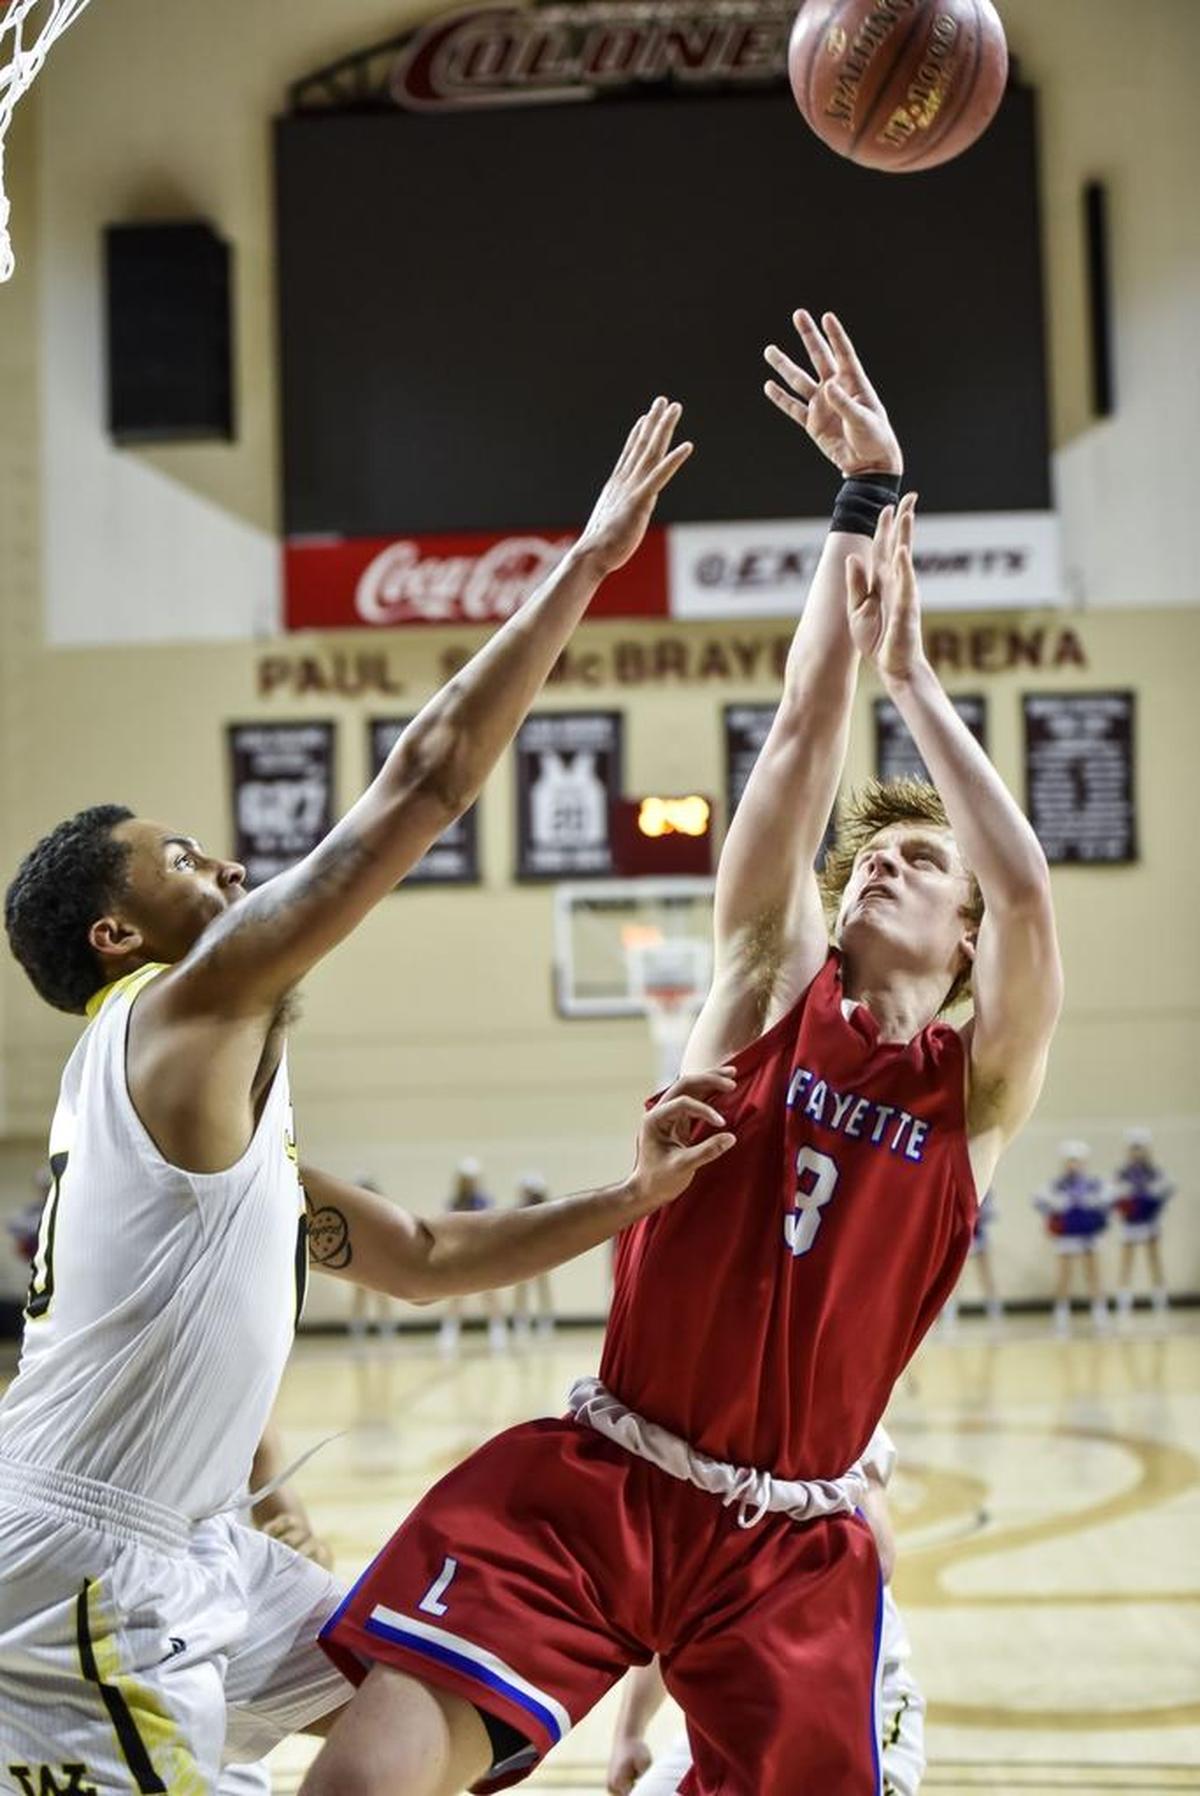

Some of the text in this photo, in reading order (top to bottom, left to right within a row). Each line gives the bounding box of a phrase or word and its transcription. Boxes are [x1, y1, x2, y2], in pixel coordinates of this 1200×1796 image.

[390, 6, 790, 112] COLONE
[258, 650, 404, 700] PAUL
[929, 626, 1088, 674] RENA
[785, 1066, 930, 1163] FAYETTE
[783, 1145, 840, 1258] 3
[418, 1556, 458, 1617] L
